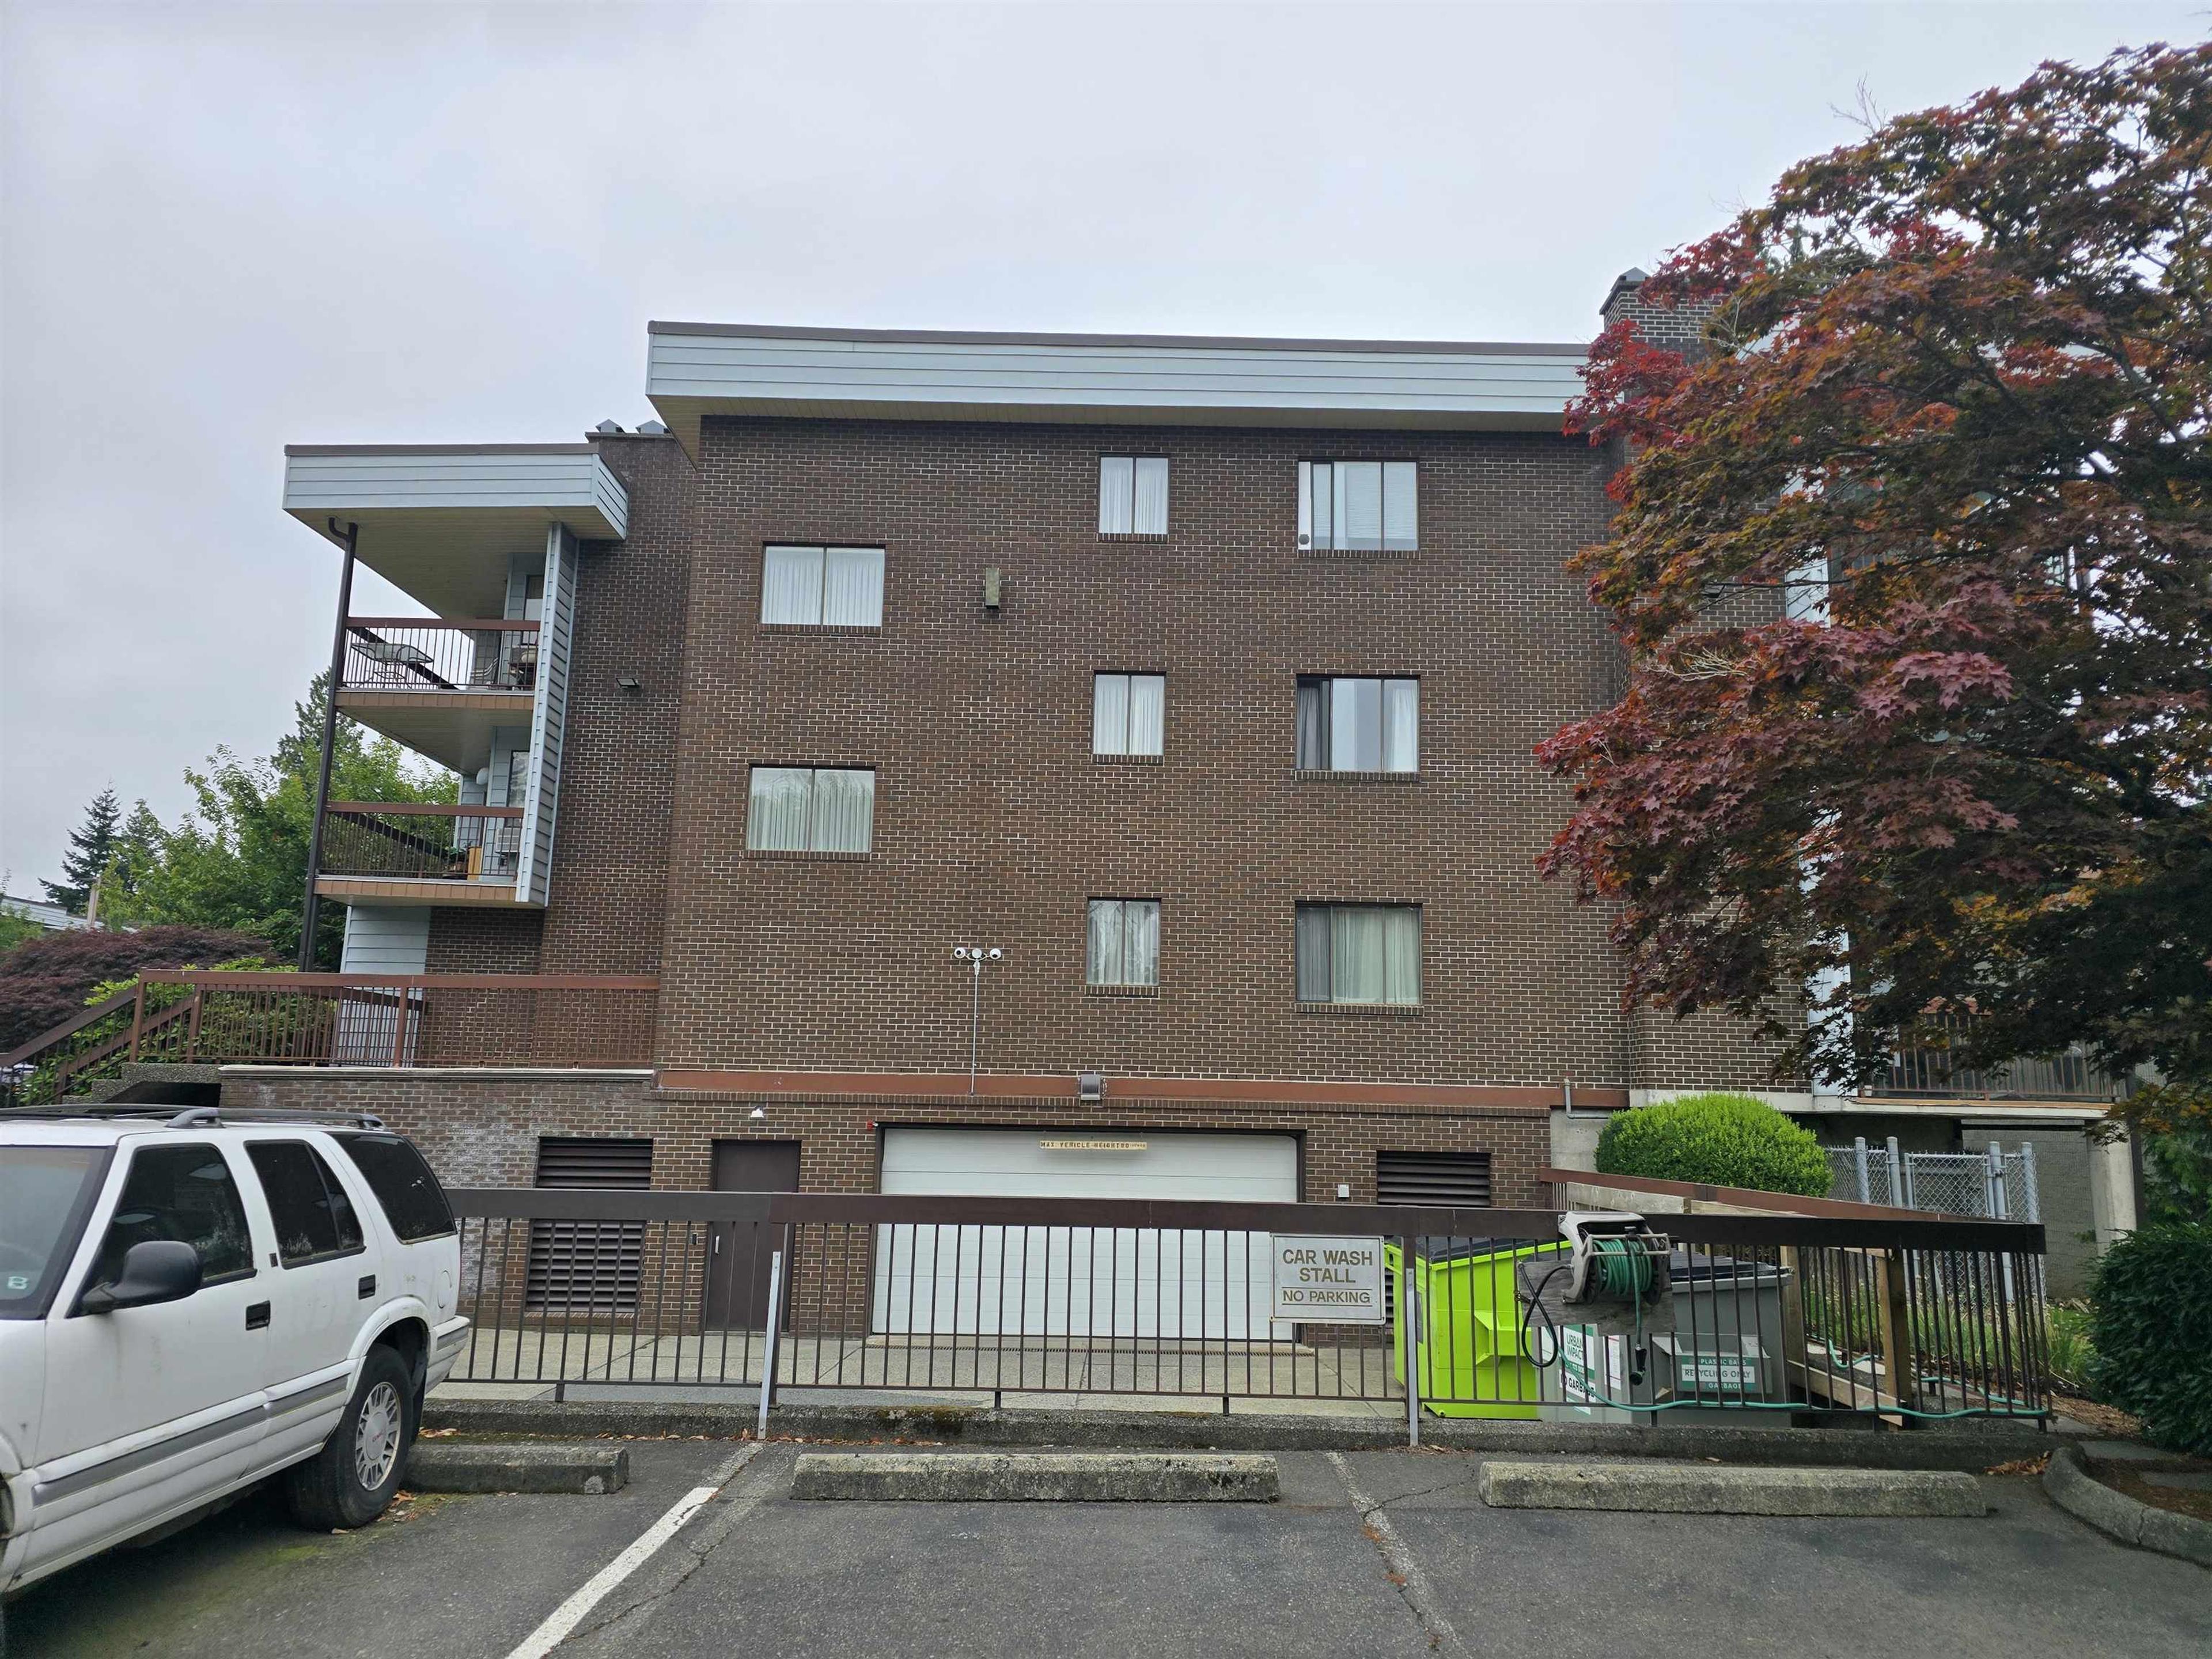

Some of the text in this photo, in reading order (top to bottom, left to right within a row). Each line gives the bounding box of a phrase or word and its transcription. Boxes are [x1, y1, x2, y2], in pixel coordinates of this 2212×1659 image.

[1283, 1249, 1373, 1266] CAR WASH
[1299, 1267, 1356, 1283] STALL
[1283, 1290, 1370, 1303] NO PARKING
[1684, 1369, 1728, 1377] REYCLIG
